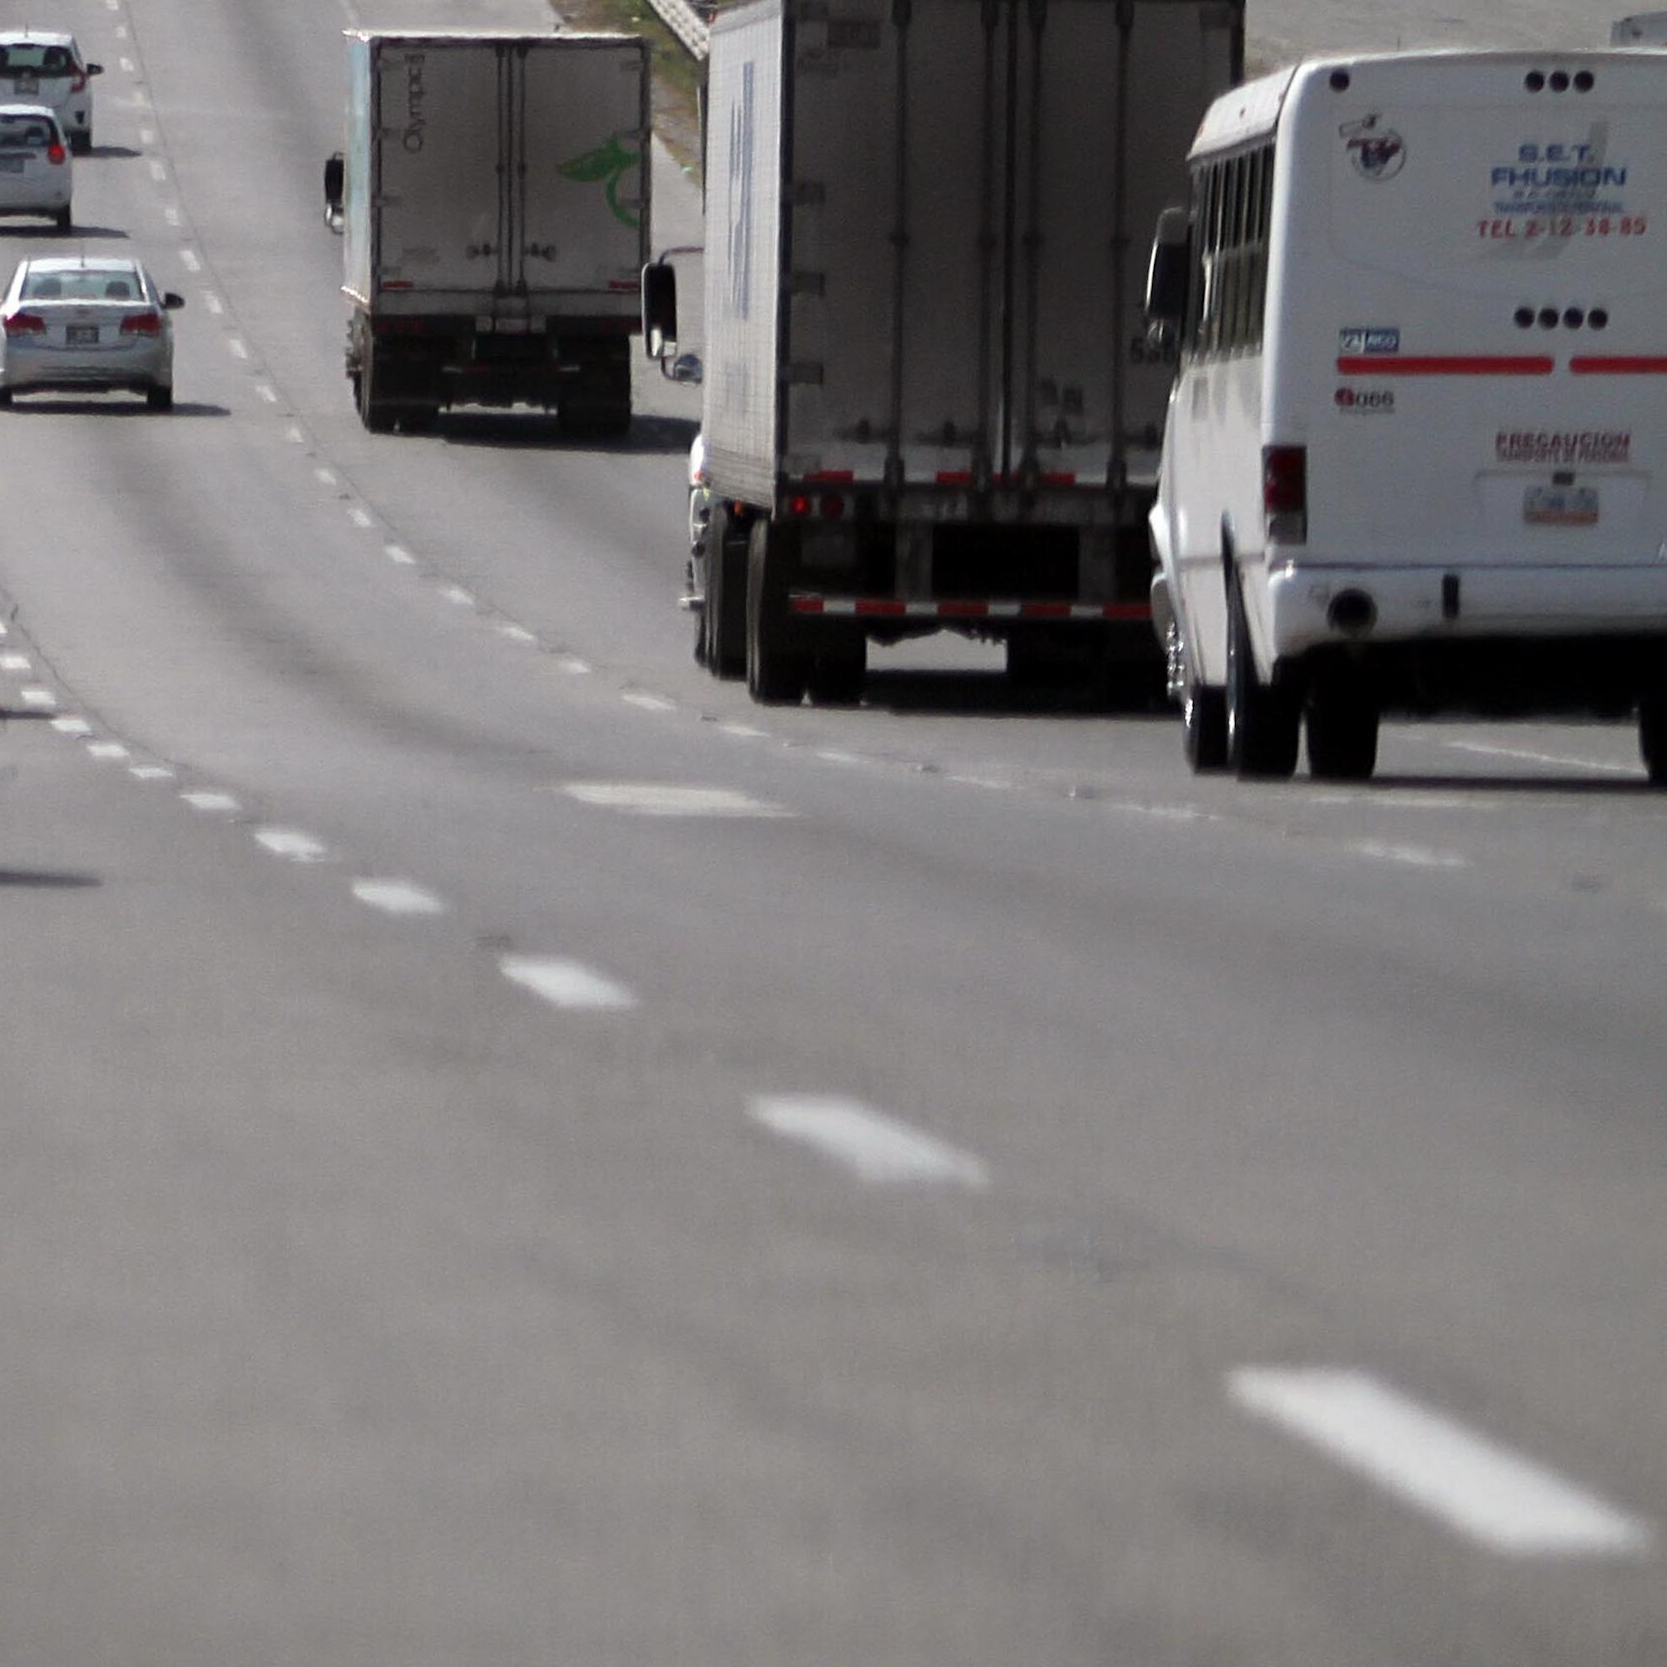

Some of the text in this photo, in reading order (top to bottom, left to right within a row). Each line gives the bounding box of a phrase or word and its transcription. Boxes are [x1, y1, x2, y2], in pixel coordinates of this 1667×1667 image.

[1491, 167, 1627, 186] FHUSION
[1478, 219, 1515, 238] TEL
[1495, 433, 1630, 448] PRECAUCION
